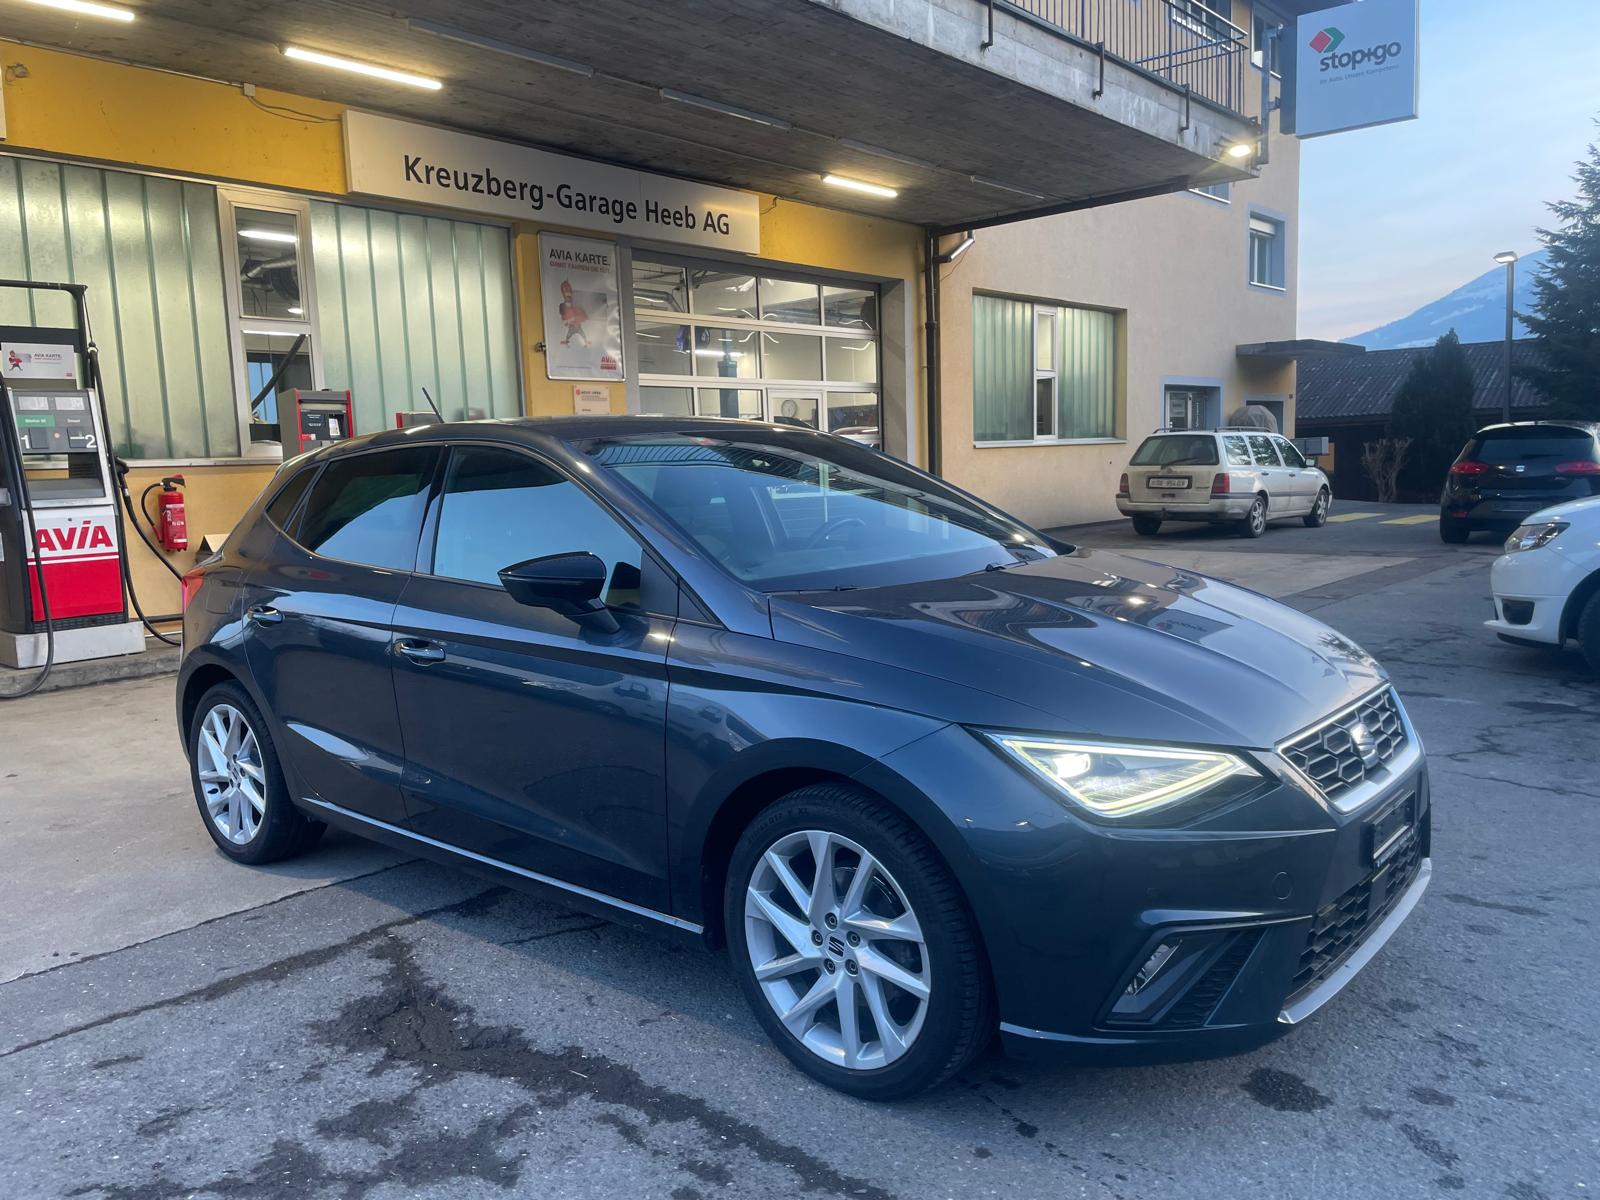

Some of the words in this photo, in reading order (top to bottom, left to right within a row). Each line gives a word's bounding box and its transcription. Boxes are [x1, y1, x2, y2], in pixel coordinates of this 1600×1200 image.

[404, 154, 637, 224] Kreuzberg-Garage
[645, 200, 696, 229] Heeb
[703, 211, 730, 235] AG
[549, 248, 573, 261] AVIA
[575, 252, 611, 266] KARTE.
[20, 434, 30, 449] 1
[84, 434, 97, 448] 2
[32, 520, 113, 553] AVIA
